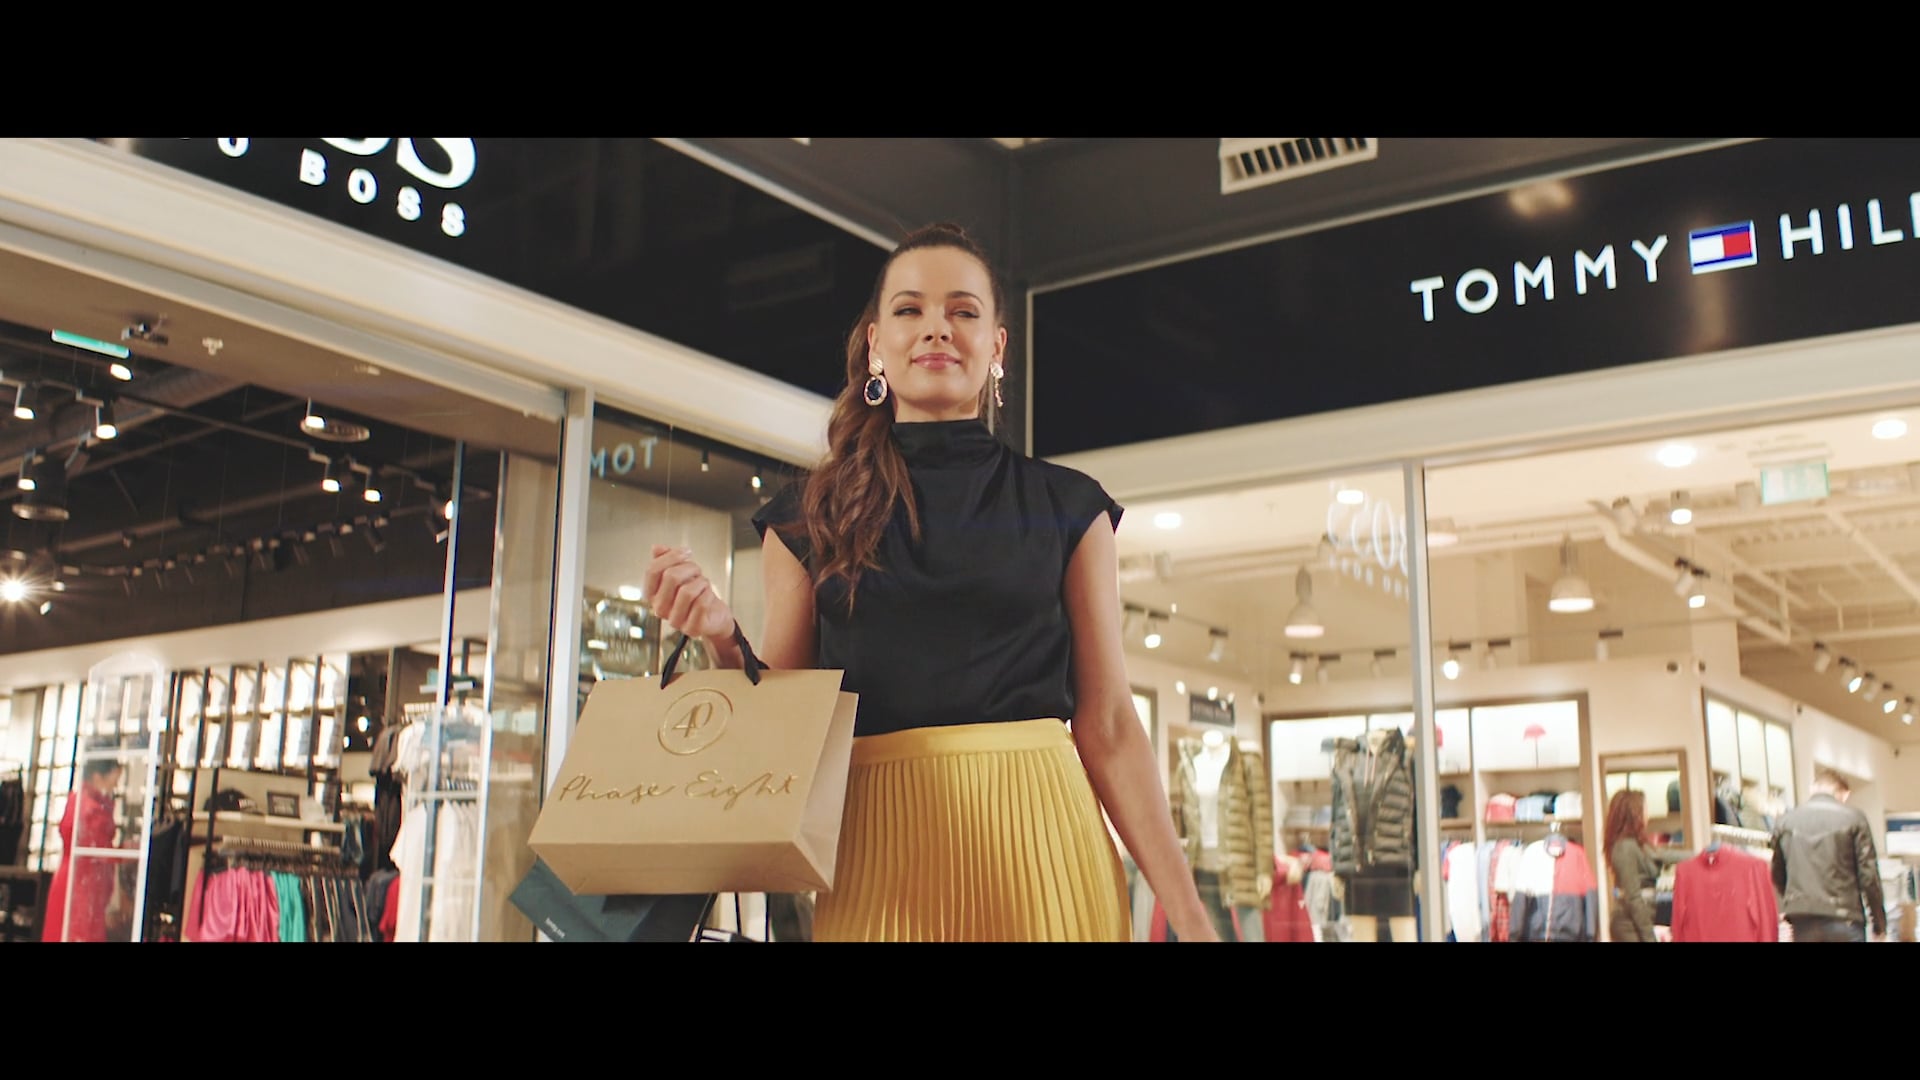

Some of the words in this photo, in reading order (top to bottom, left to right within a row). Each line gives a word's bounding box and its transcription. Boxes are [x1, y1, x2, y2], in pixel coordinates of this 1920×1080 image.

[300, 148, 465, 238] BOSS
[1410, 235, 1669, 322] TOMMY
[559, 774, 677, 804] Phase
[685, 769, 800, 811] Eight
